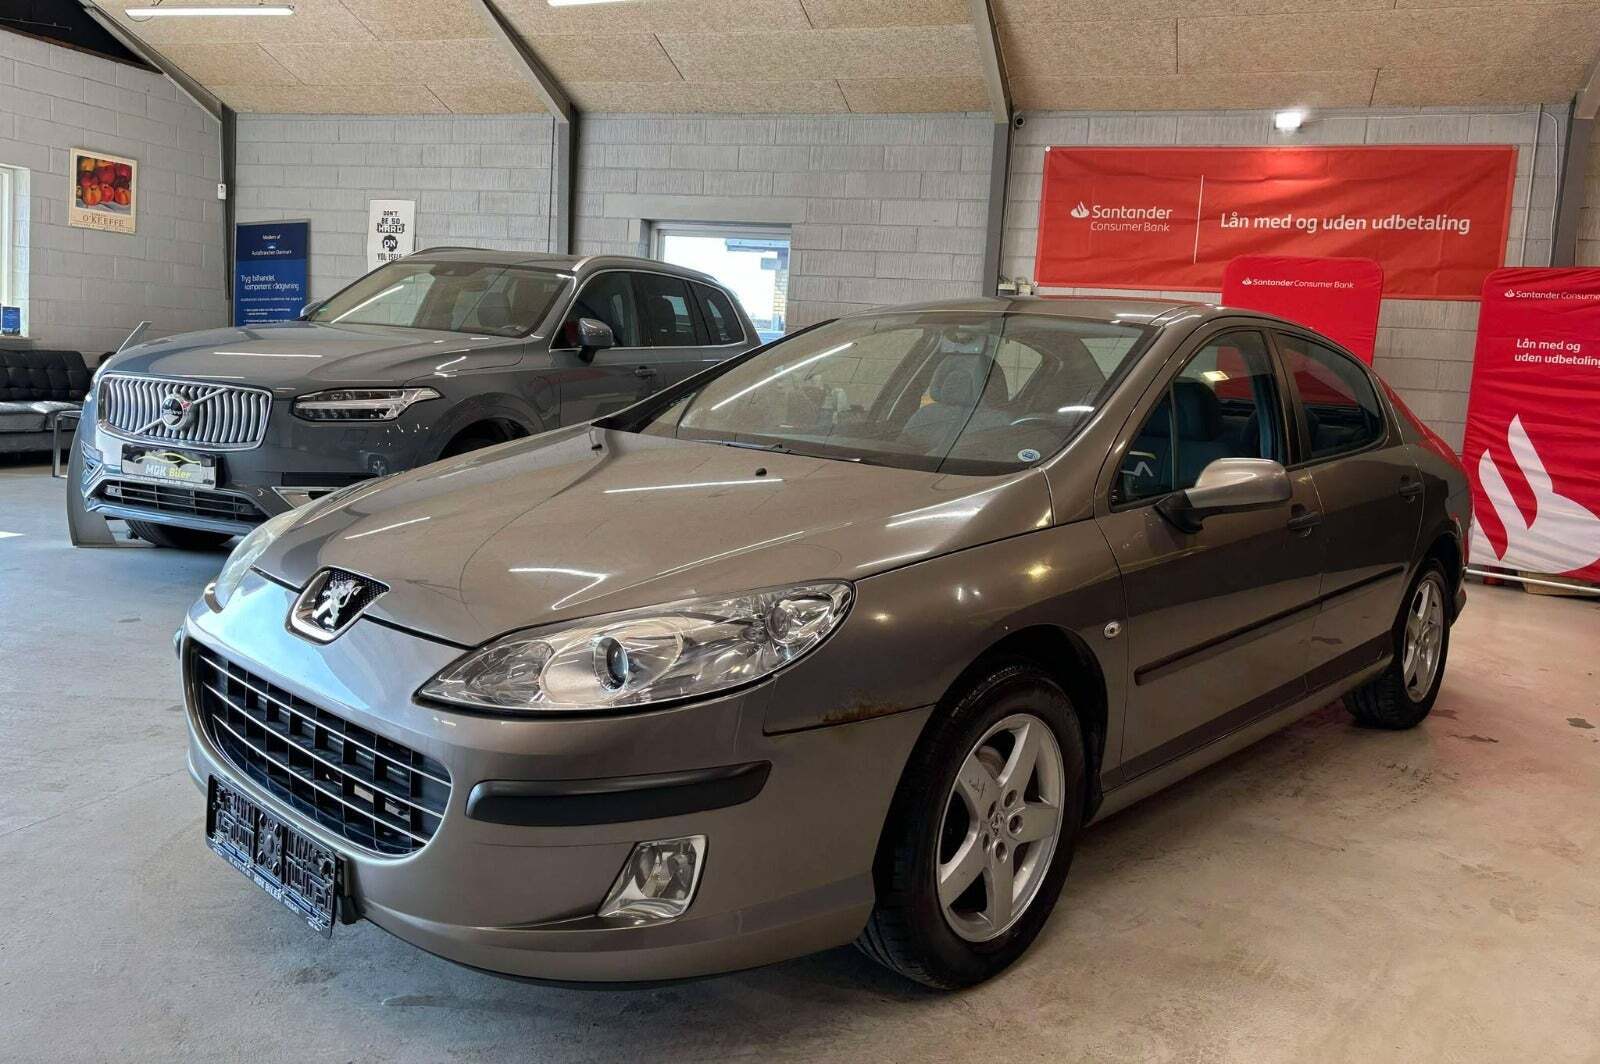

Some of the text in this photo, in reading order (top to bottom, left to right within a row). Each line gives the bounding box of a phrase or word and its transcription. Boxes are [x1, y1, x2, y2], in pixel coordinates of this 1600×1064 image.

[1091, 205, 1173, 220] Santander
[1090, 221, 1170, 232] Consumer Bank
[1220, 212, 1471, 235] Lån med og uden udbetaling
[383, 239, 397, 248] ON
[1253, 278, 1354, 289] Santander Consumer Bank
[1516, 290, 1600, 300] Santander Consume
[1516, 338, 1580, 353] Lån med og
[1514, 352, 1542, 363] uden
